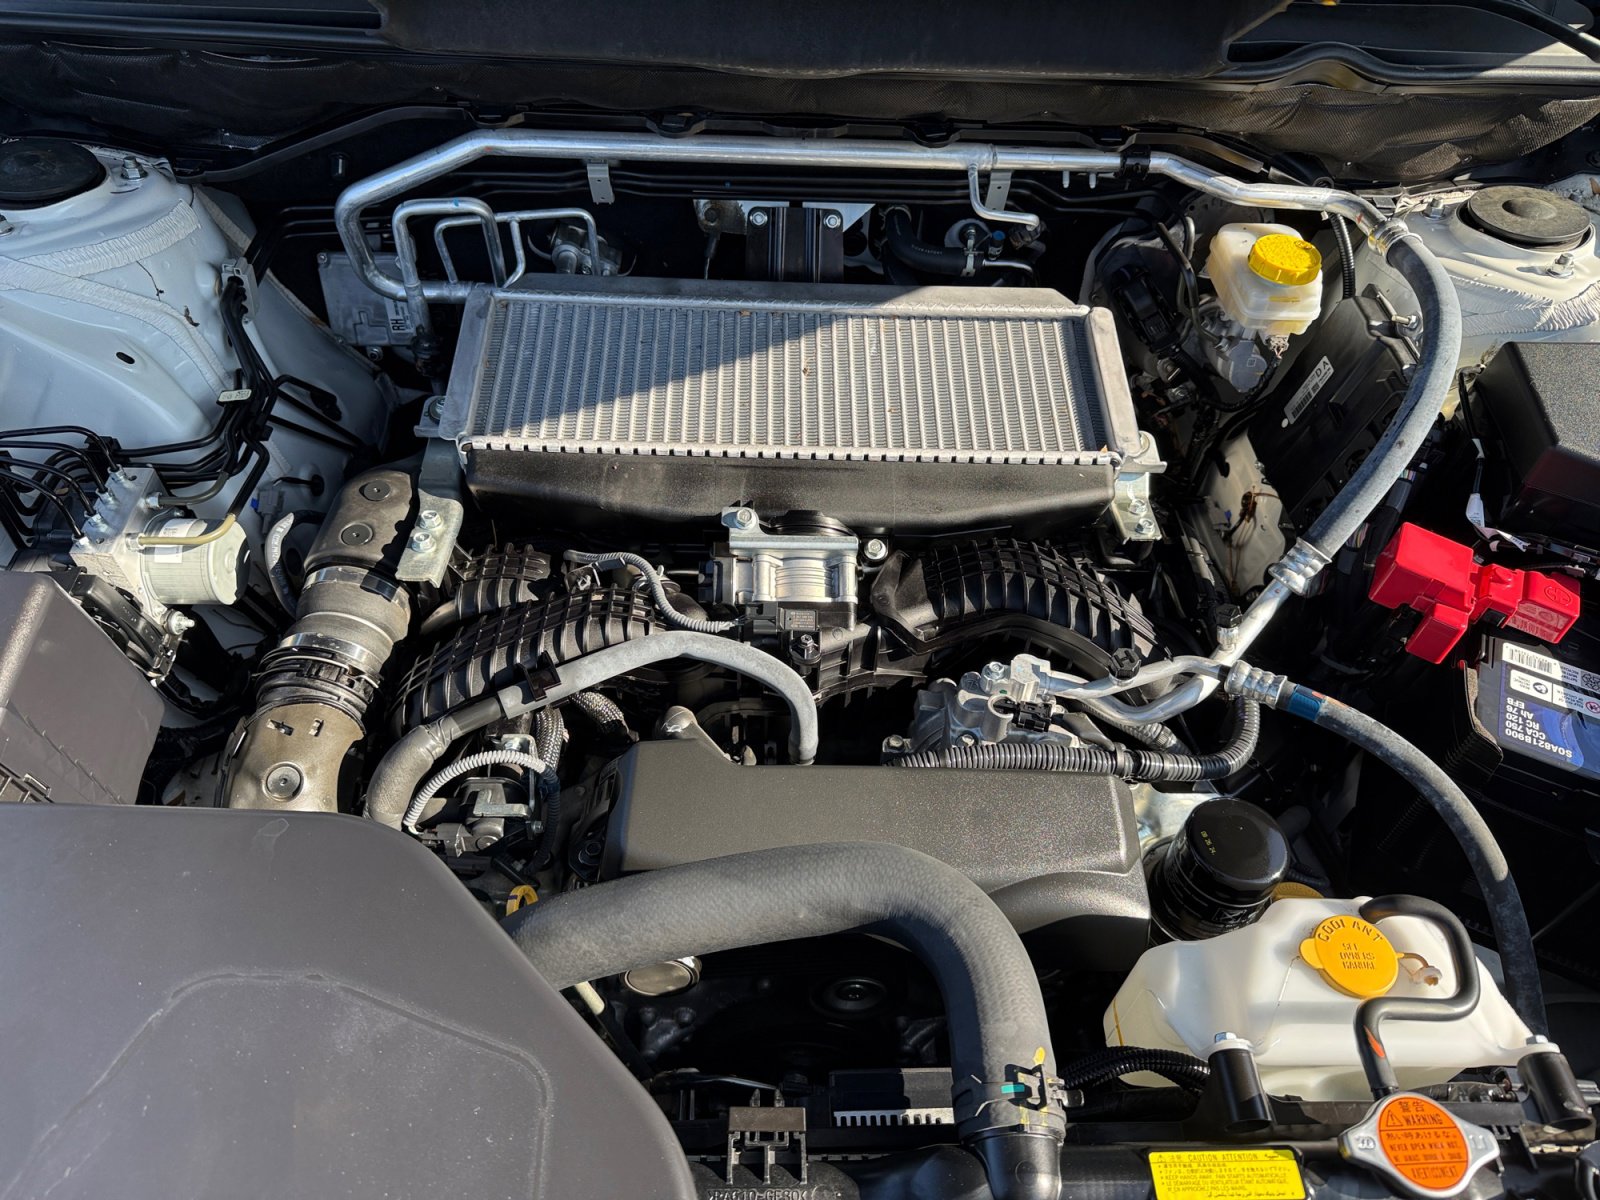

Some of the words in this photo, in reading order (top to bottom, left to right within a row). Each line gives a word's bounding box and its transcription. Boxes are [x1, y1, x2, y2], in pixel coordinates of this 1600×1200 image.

[390, 318, 406, 331] RH
[1506, 697, 1525, 710] EFB
[1506, 704, 1519, 715] 76
[1505, 712, 1524, 724] 120
[1520, 709, 1534, 720] Ah
[1505, 720, 1524, 733] 750
[1525, 720, 1540, 730] RC
[1525, 727, 1546, 740] CCA
[1505, 728, 1572, 758] SOA821B900
[1317, 918, 1383, 942] COOLANT
[1402, 1113, 1444, 1126] WARNING
[1187, 1153, 1218, 1161] CAUTION
[1222, 1152, 1258, 1161] ATTENTION
